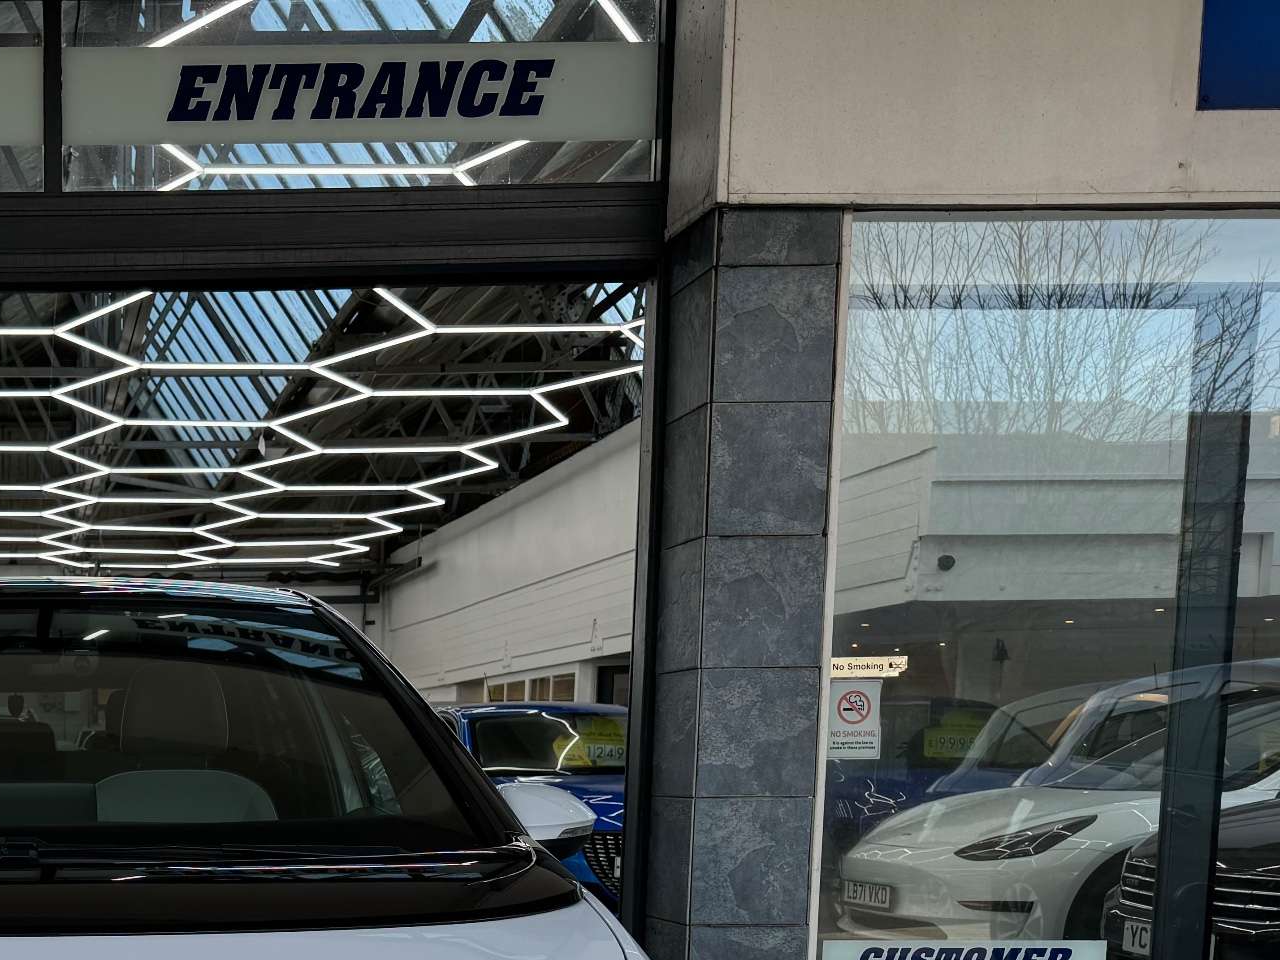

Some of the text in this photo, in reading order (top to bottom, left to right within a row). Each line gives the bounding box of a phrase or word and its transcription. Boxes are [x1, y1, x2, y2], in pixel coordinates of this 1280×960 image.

[165, 59, 555, 123] ENTRANCE
[832, 662, 884, 674] No Smoking
[830, 730, 841, 738] NO
[847, 882, 887, 905] LB71 VKD
[1130, 924, 1149, 949] YC
